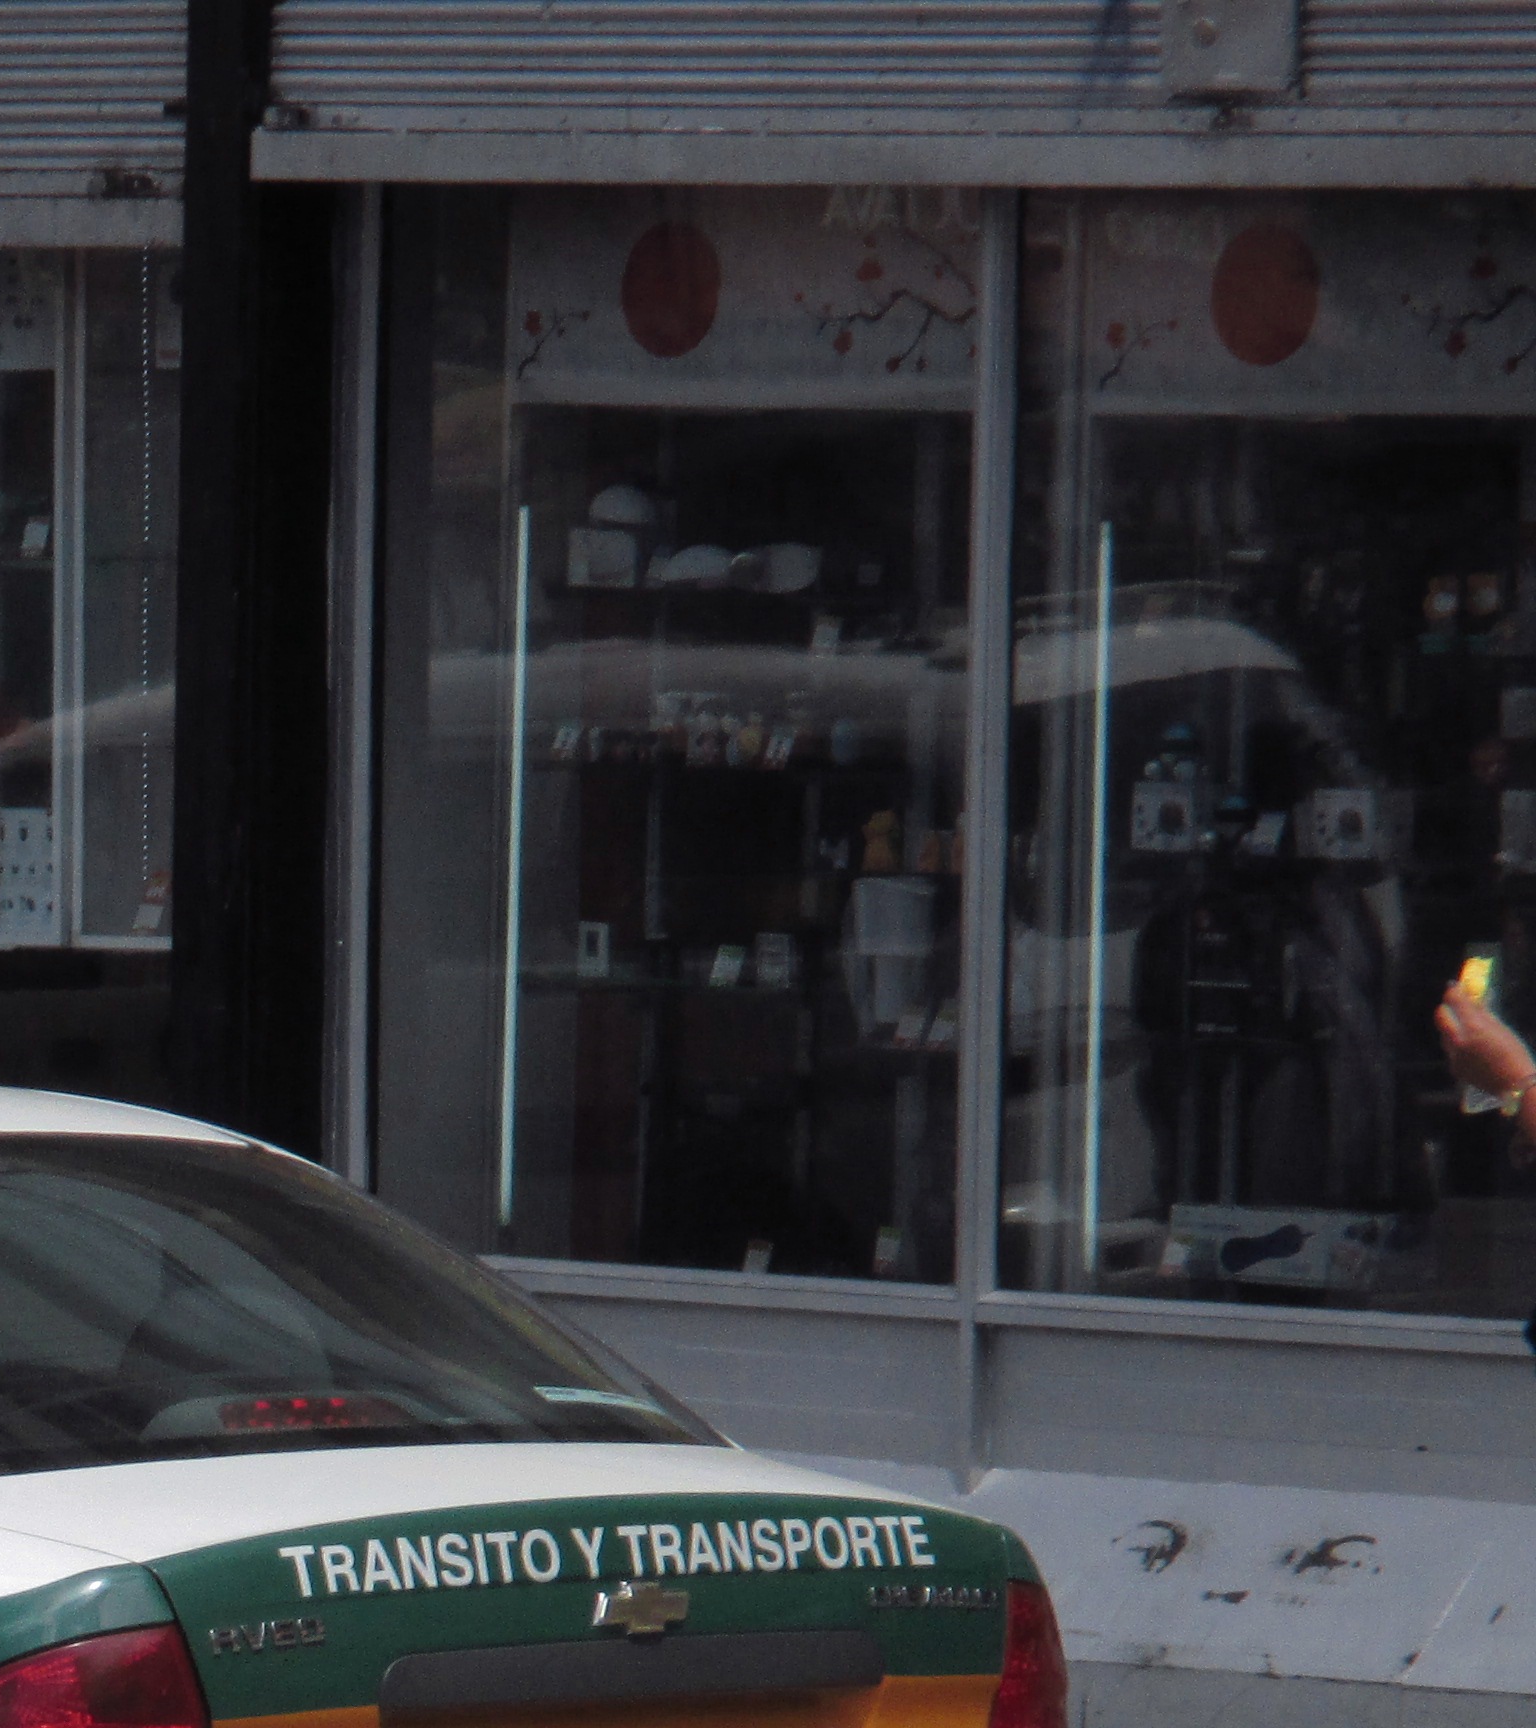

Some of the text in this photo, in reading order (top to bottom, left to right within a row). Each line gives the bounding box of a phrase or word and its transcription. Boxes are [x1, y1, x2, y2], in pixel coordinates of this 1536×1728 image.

[278, 1515, 936, 1599] TRANSITO Y TRANSPORTE
